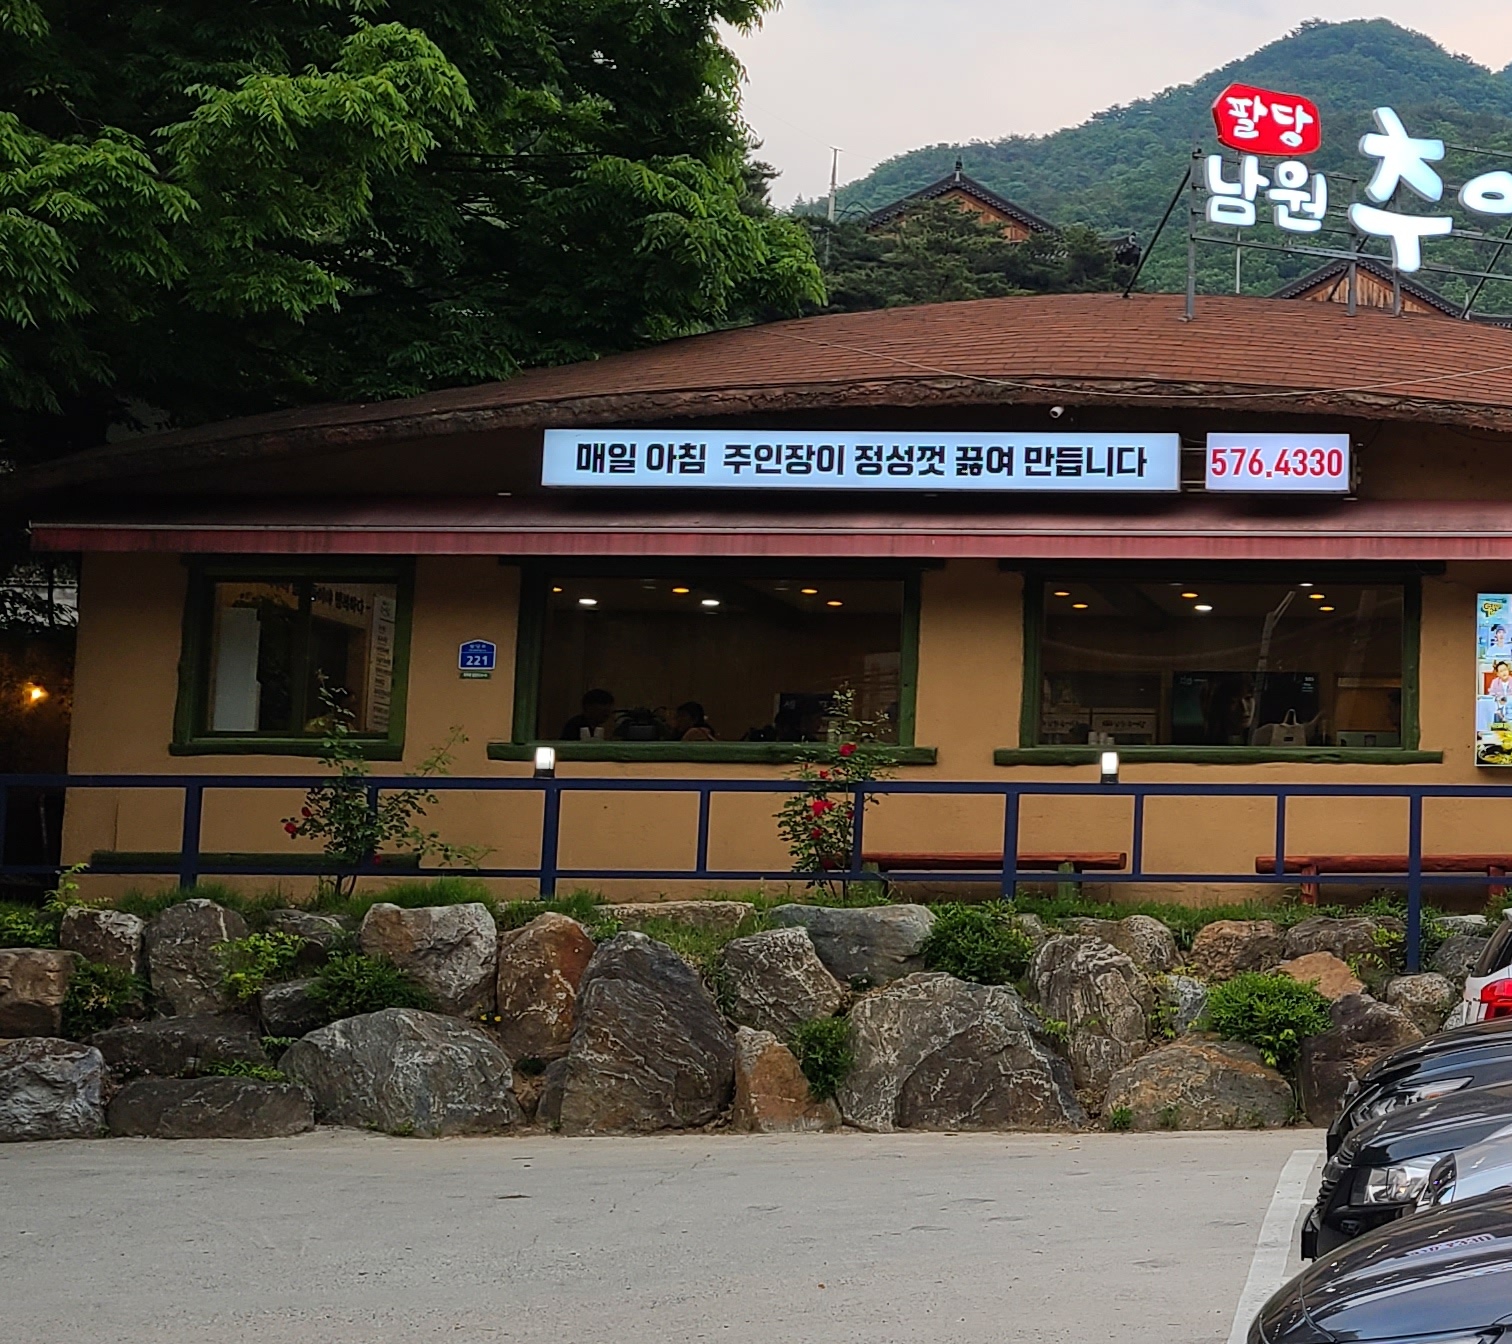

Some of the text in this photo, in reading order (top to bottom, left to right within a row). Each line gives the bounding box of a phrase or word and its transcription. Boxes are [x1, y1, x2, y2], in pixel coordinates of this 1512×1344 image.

[1225, 95, 1315, 148] 팔당
[1203, 154, 1329, 233] 남원
[575, 442, 1148, 478] 매일 아침 주인장이 정성껏 끓여 만듭니다
[1210, 447, 1344, 479] 576.4330
[465, 655, 488, 666] 221
